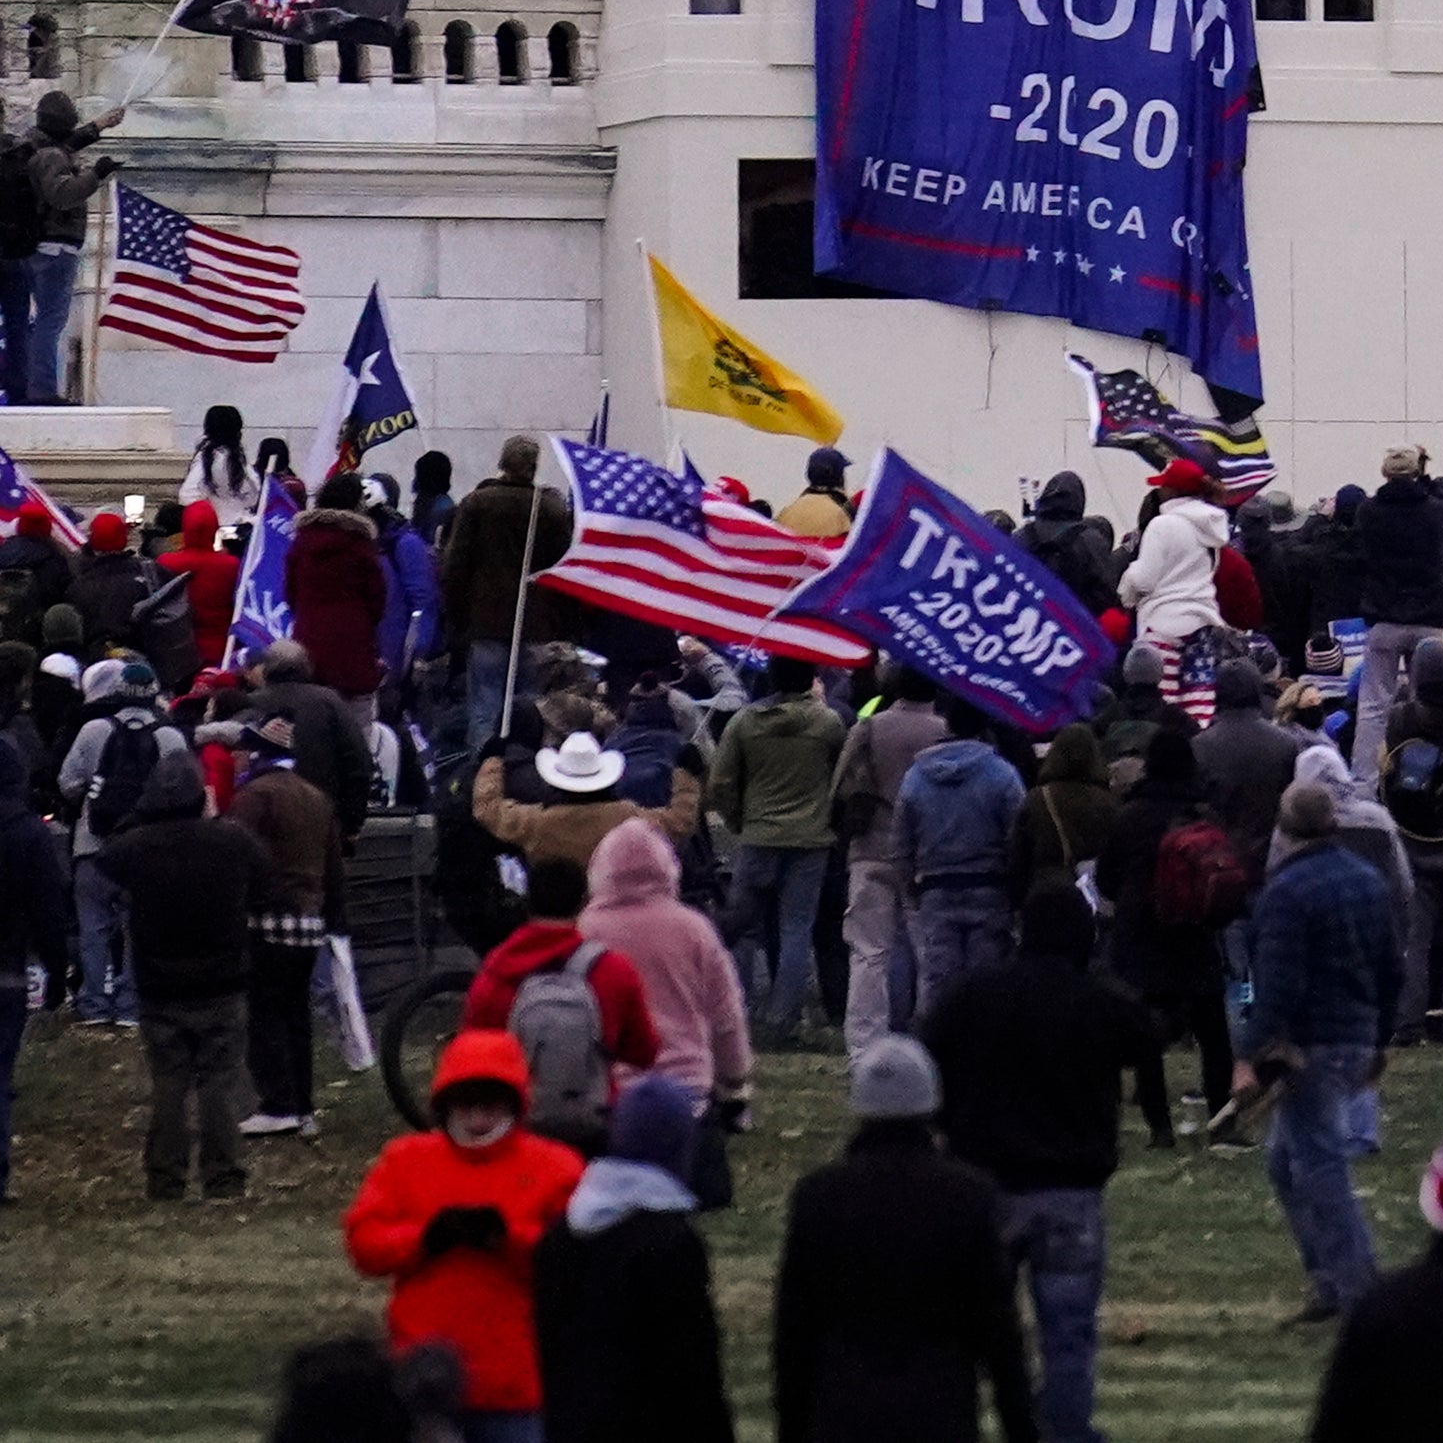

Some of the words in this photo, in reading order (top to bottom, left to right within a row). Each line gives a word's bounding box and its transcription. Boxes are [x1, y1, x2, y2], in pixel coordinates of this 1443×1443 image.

[862, 157, 967, 207] KEEP
[982, 179, 1147, 240] AMERCA
[899, 508, 1085, 676] TRUMP
